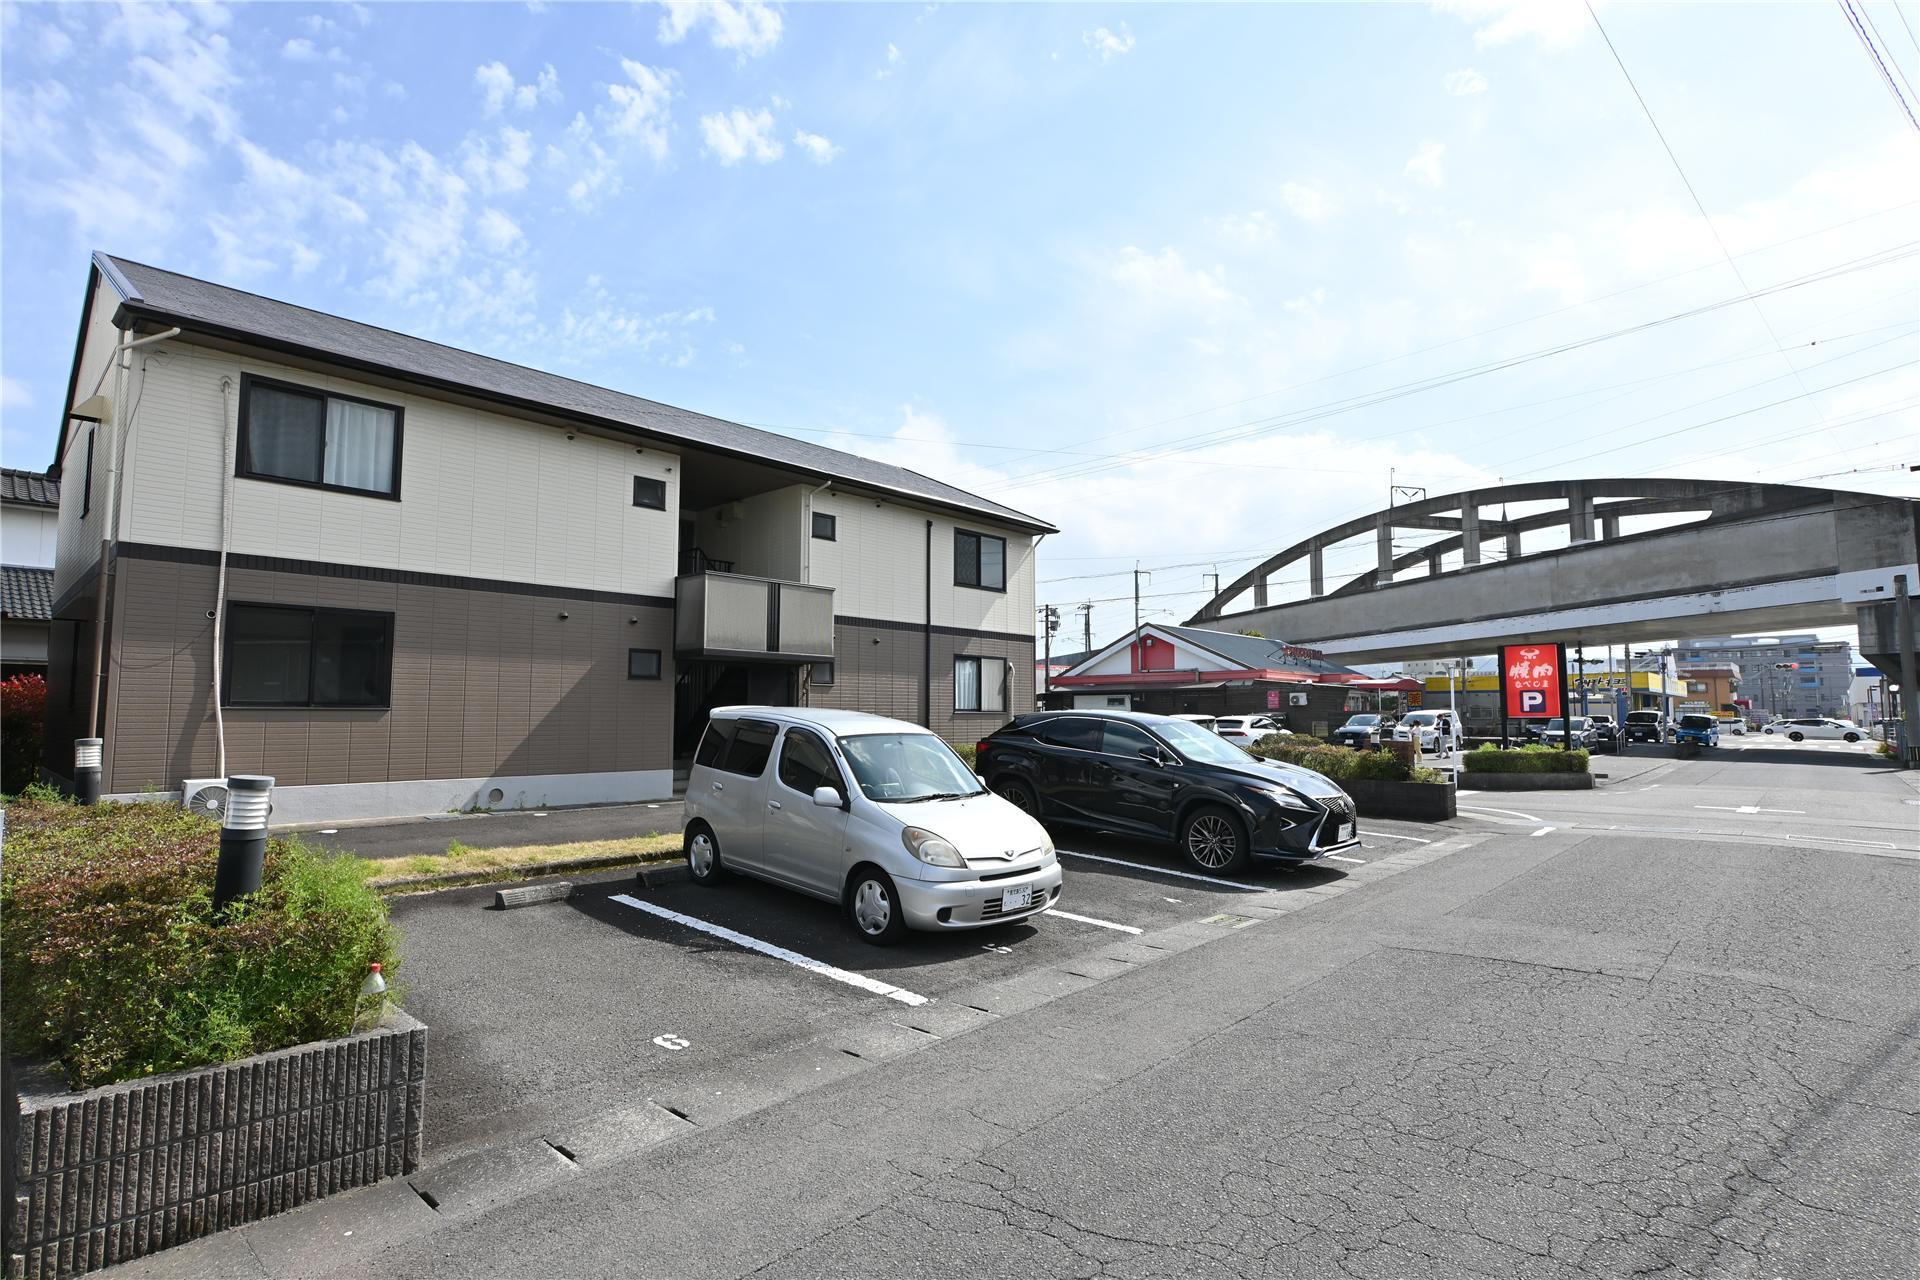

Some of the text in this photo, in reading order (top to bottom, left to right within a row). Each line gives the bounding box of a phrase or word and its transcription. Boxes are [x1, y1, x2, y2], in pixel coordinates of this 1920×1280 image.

[1509, 661, 1553, 680] 焼肉
[1523, 692, 1543, 711] P
[652, 1033, 691, 1050] 6
